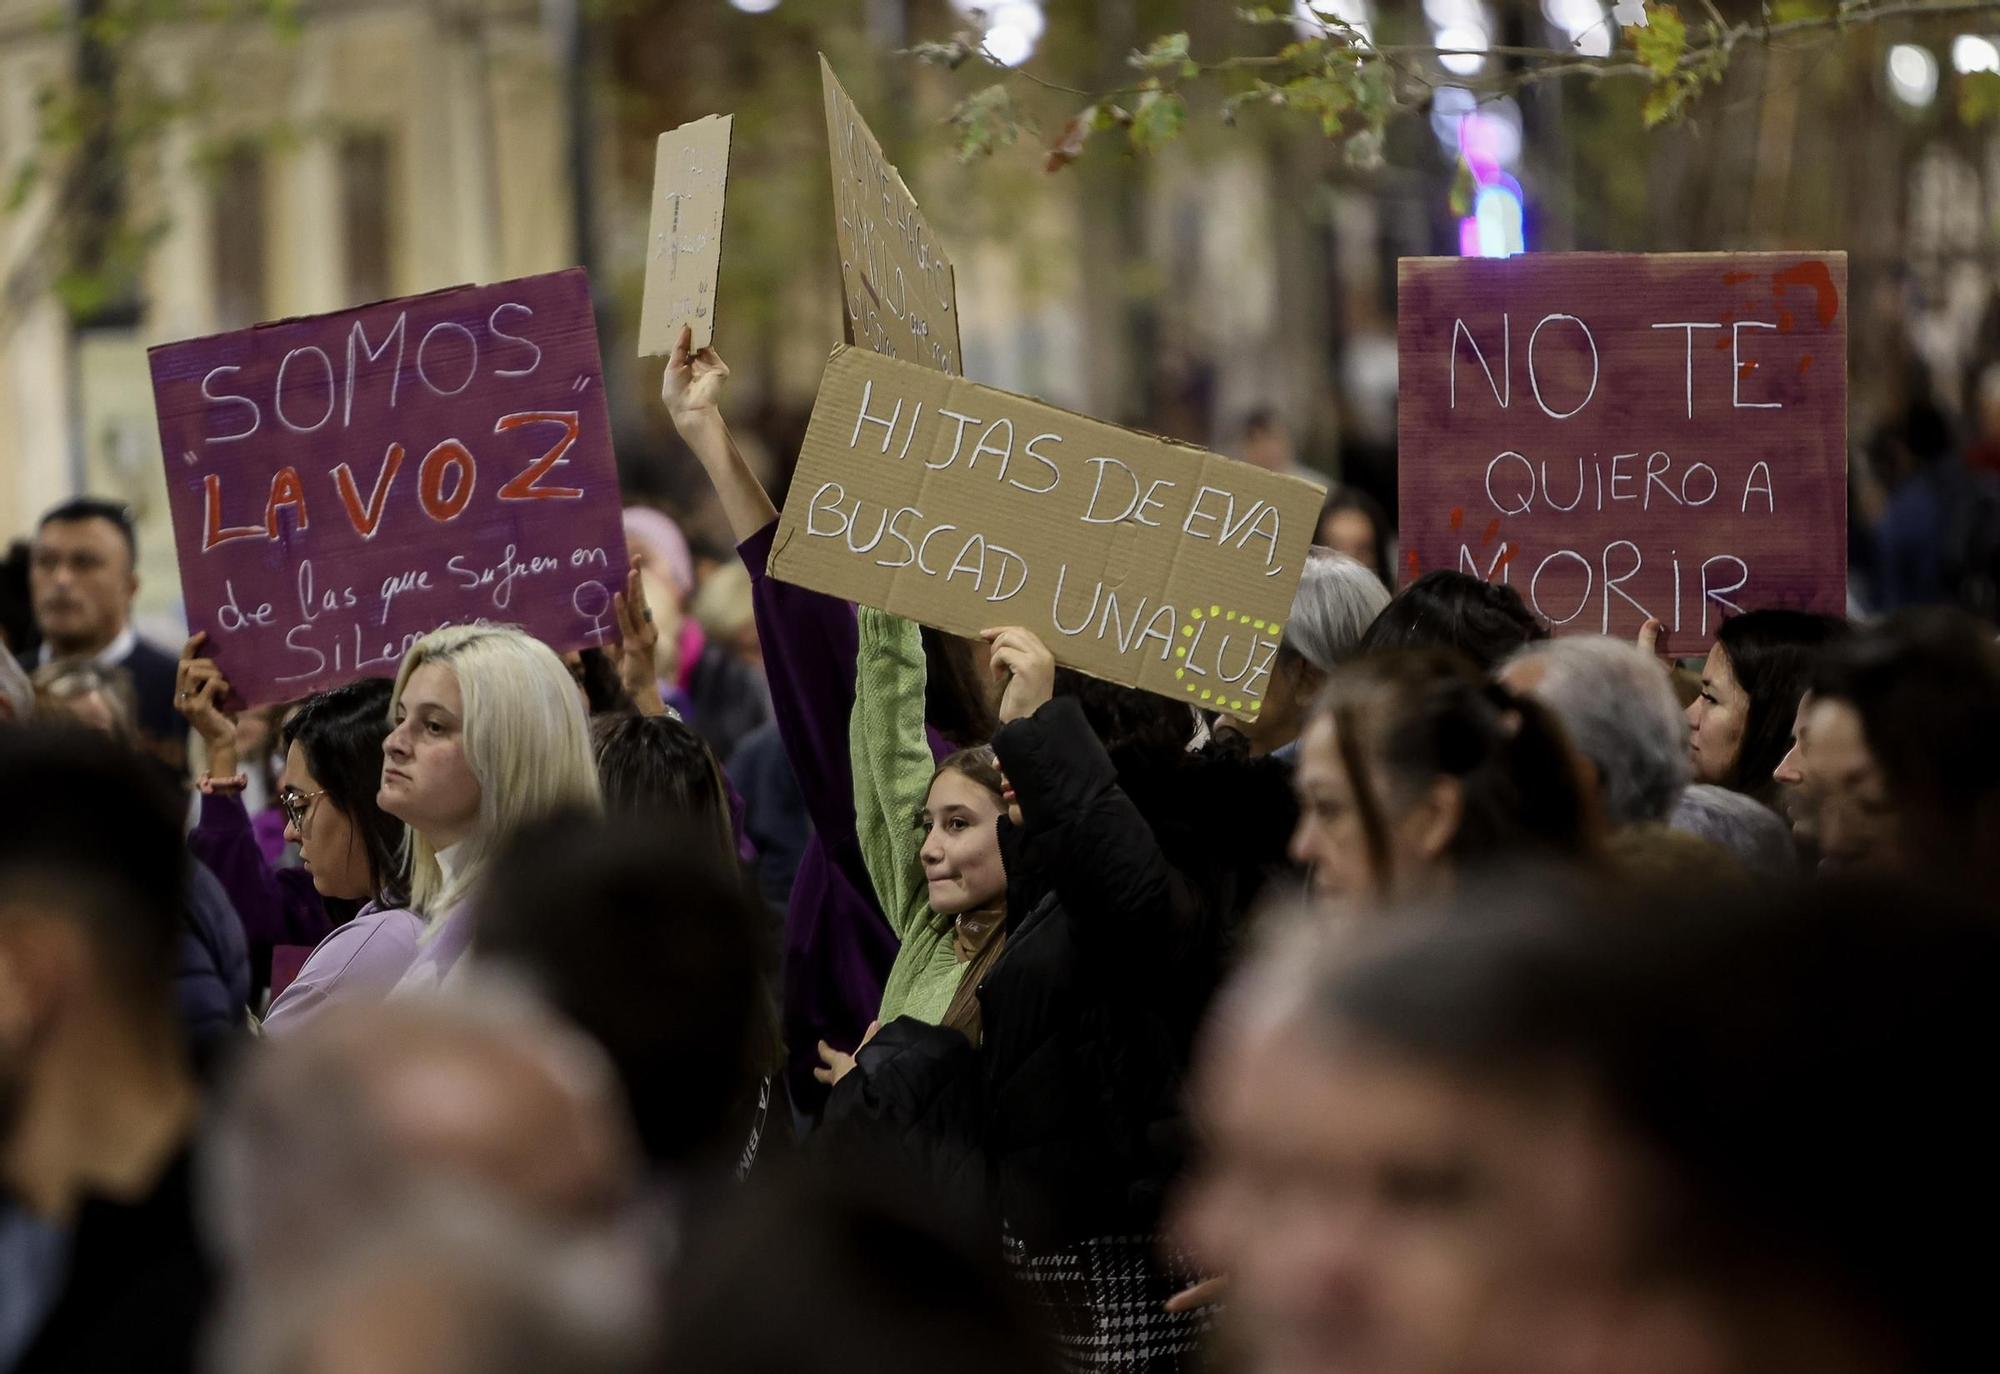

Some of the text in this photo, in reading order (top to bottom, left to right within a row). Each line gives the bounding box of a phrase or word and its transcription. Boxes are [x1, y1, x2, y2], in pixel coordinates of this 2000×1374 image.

[202, 302, 541, 442] SOMOS
[1450, 312, 1783, 420] NO TE
[849, 379, 1284, 578] HIJAS DE EVA,
[1741, 461, 1774, 513] A
[217, 579, 276, 631] de
[298, 559, 357, 622] las
[379, 572, 433, 625] que
[571, 546, 609, 568] en
[806, 481, 1280, 697] BUSCAD UNA LUZ
